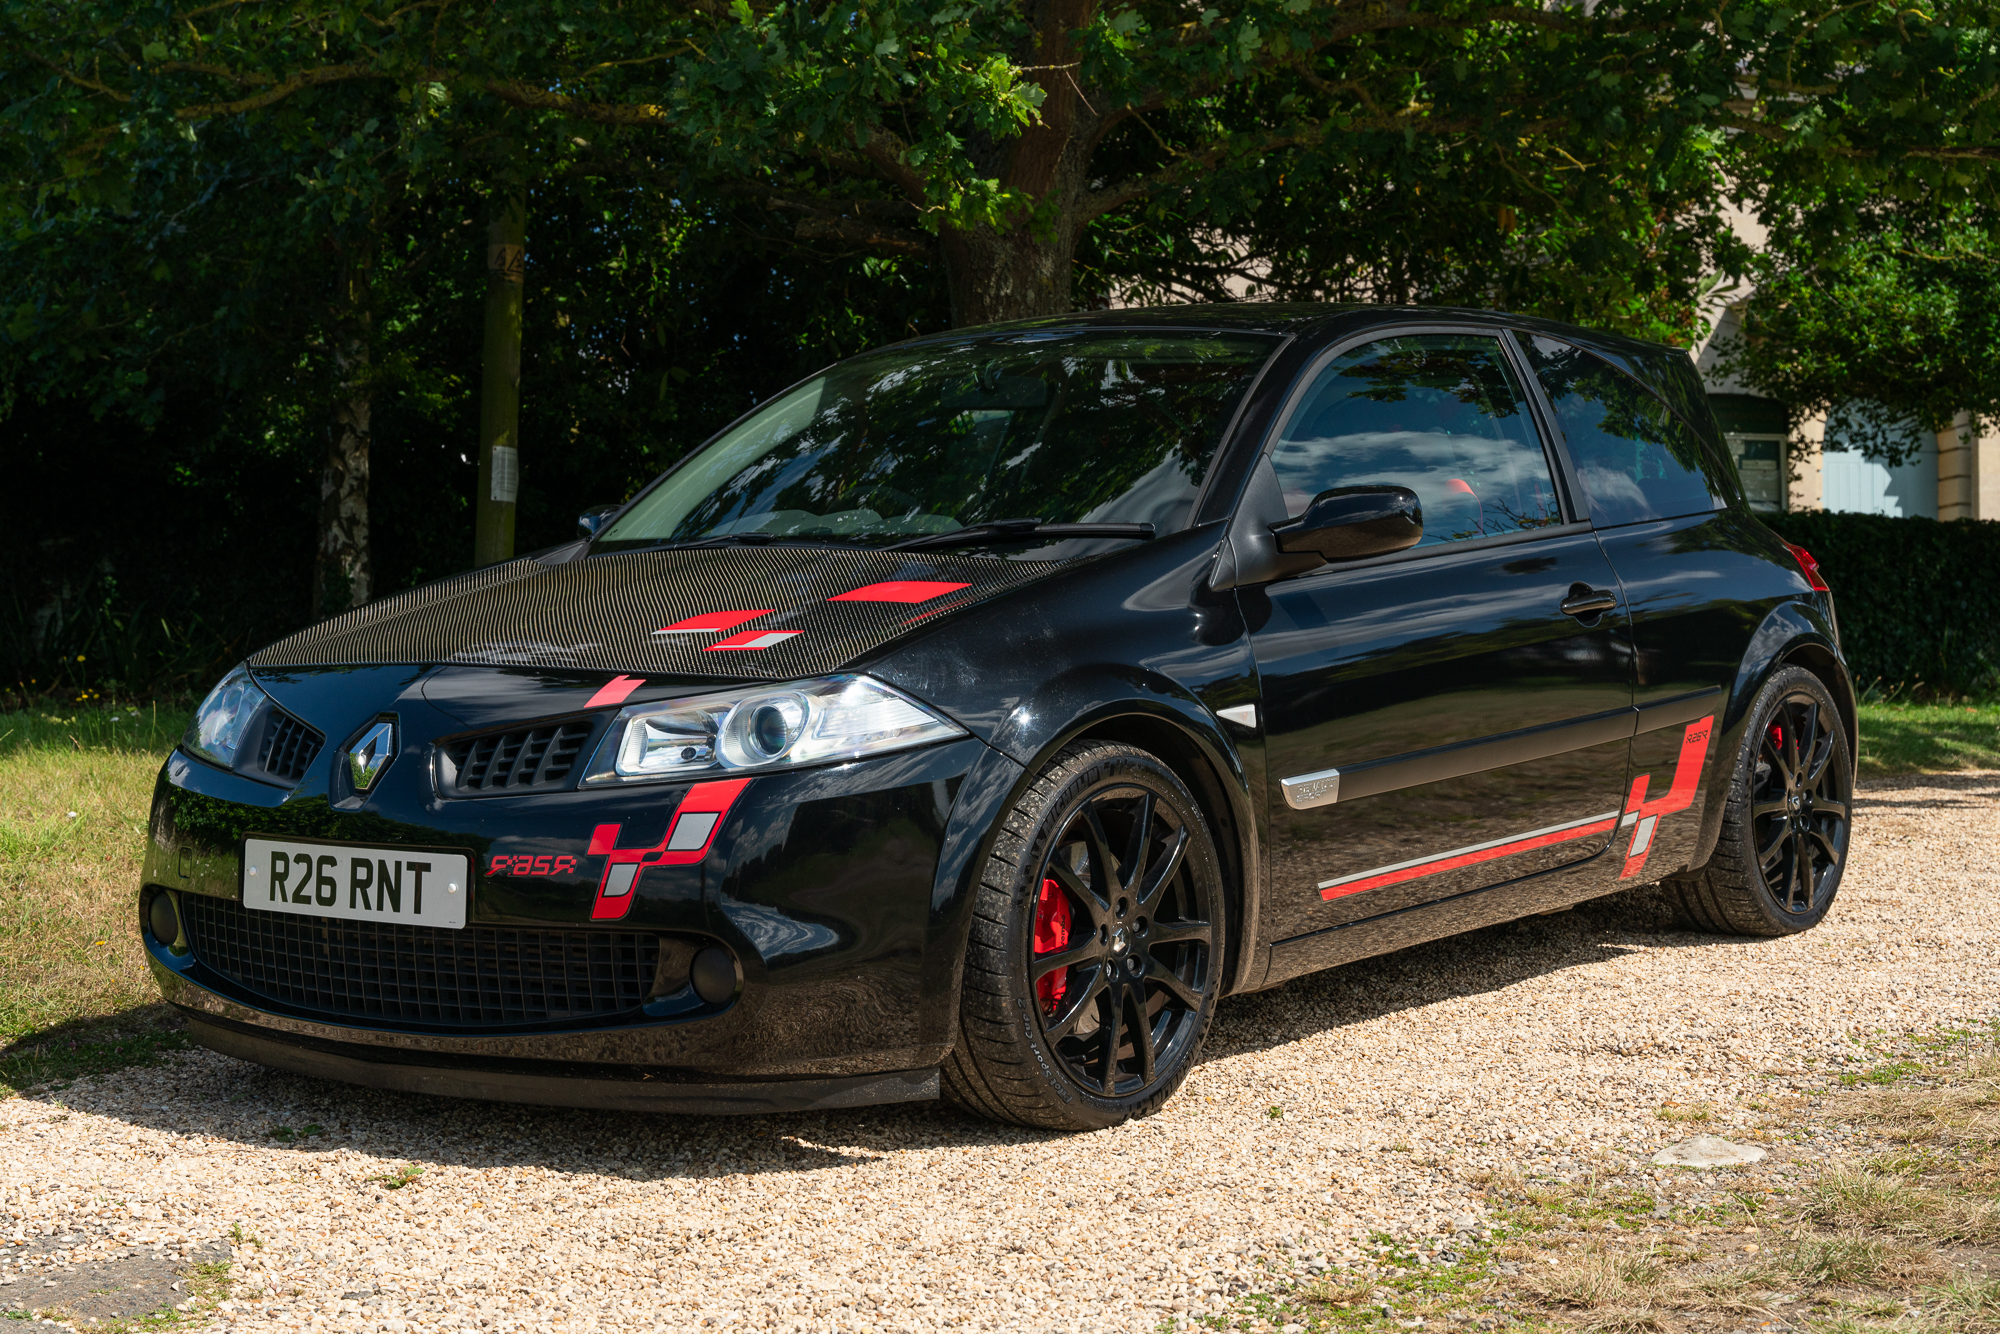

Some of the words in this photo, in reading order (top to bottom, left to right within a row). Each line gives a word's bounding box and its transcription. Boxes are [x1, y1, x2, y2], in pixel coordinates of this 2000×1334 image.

[1042, 766, 1100, 837] MICHELIN
[269, 850, 338, 907] R26
[349, 857, 432, 915] RNT
[1017, 997, 1027, 1009] 2
[1029, 1041, 1053, 1079] Sport
[1049, 1077, 1073, 1104] Pilot
